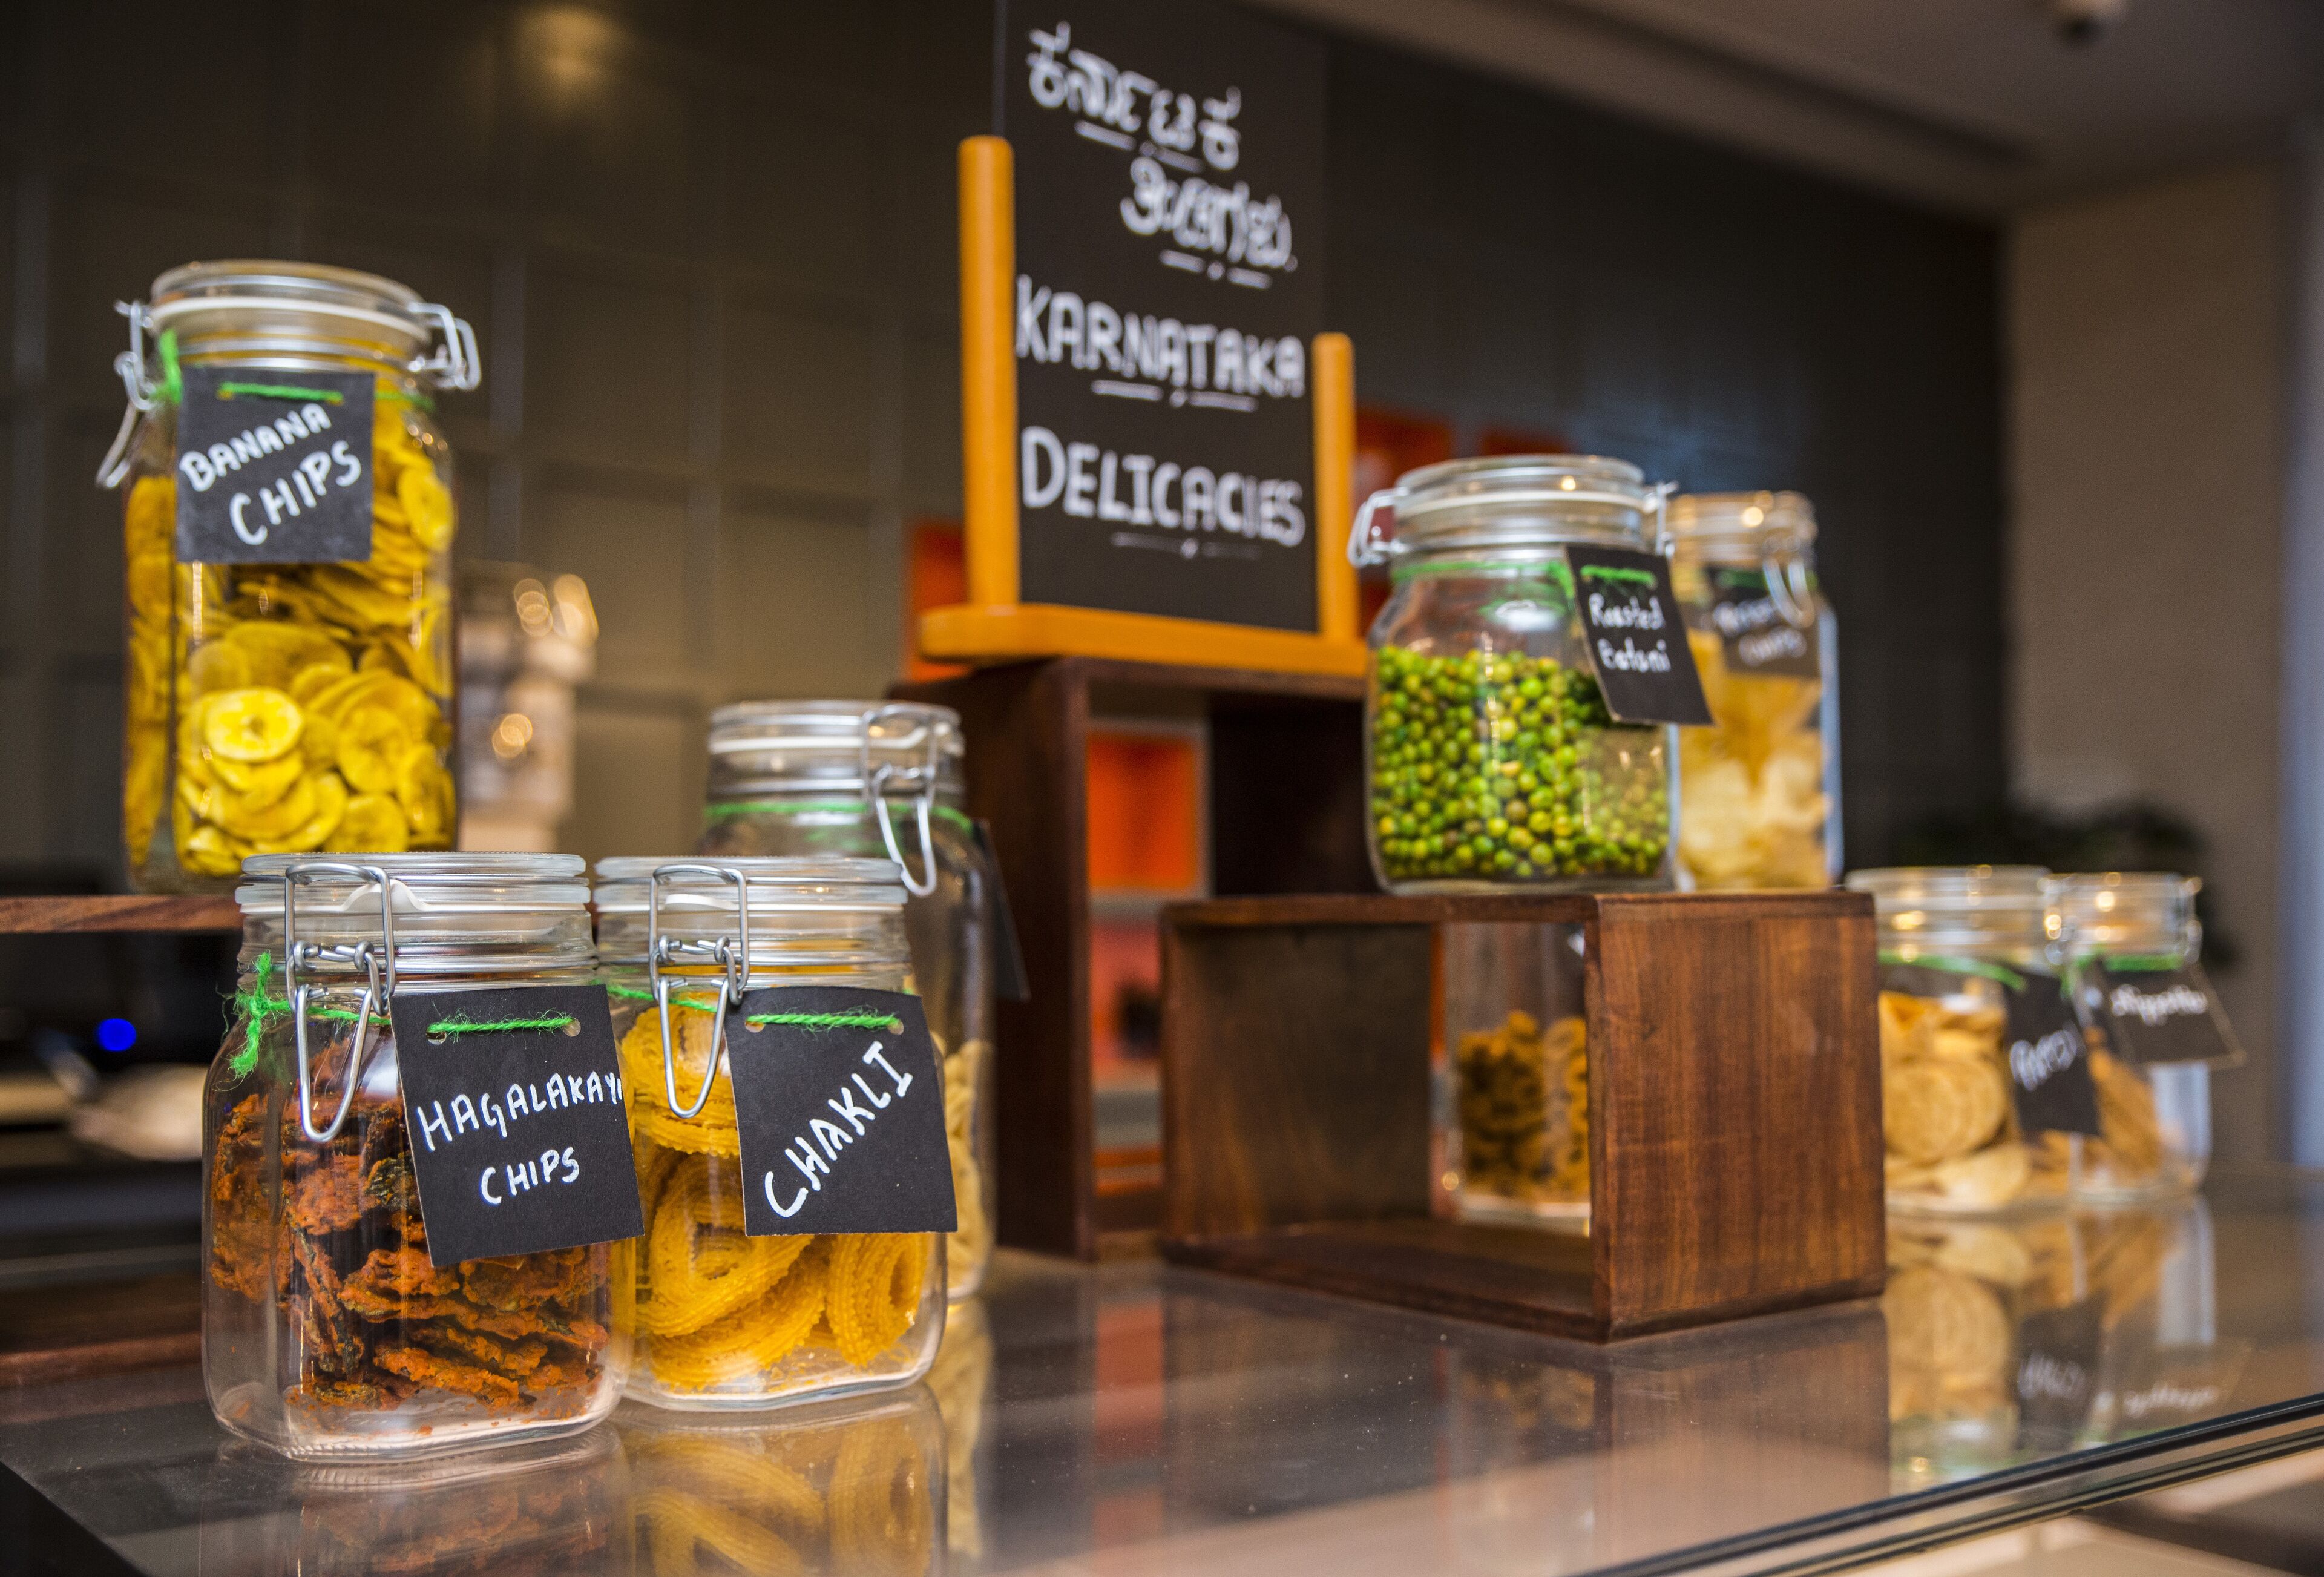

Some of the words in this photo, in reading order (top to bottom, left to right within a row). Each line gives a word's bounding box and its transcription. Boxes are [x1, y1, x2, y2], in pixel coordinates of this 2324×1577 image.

[1015, 274, 1306, 398] KARNATAKA
[179, 403, 332, 492] BANANA
[229, 440, 362, 545] CHIPS
[1021, 426, 1306, 547] DELICACIES
[417, 1070, 623, 1151] HAGALAKAYI
[764, 1040, 913, 1218] CHAKLI
[481, 1145, 580, 1205] CHIPS
